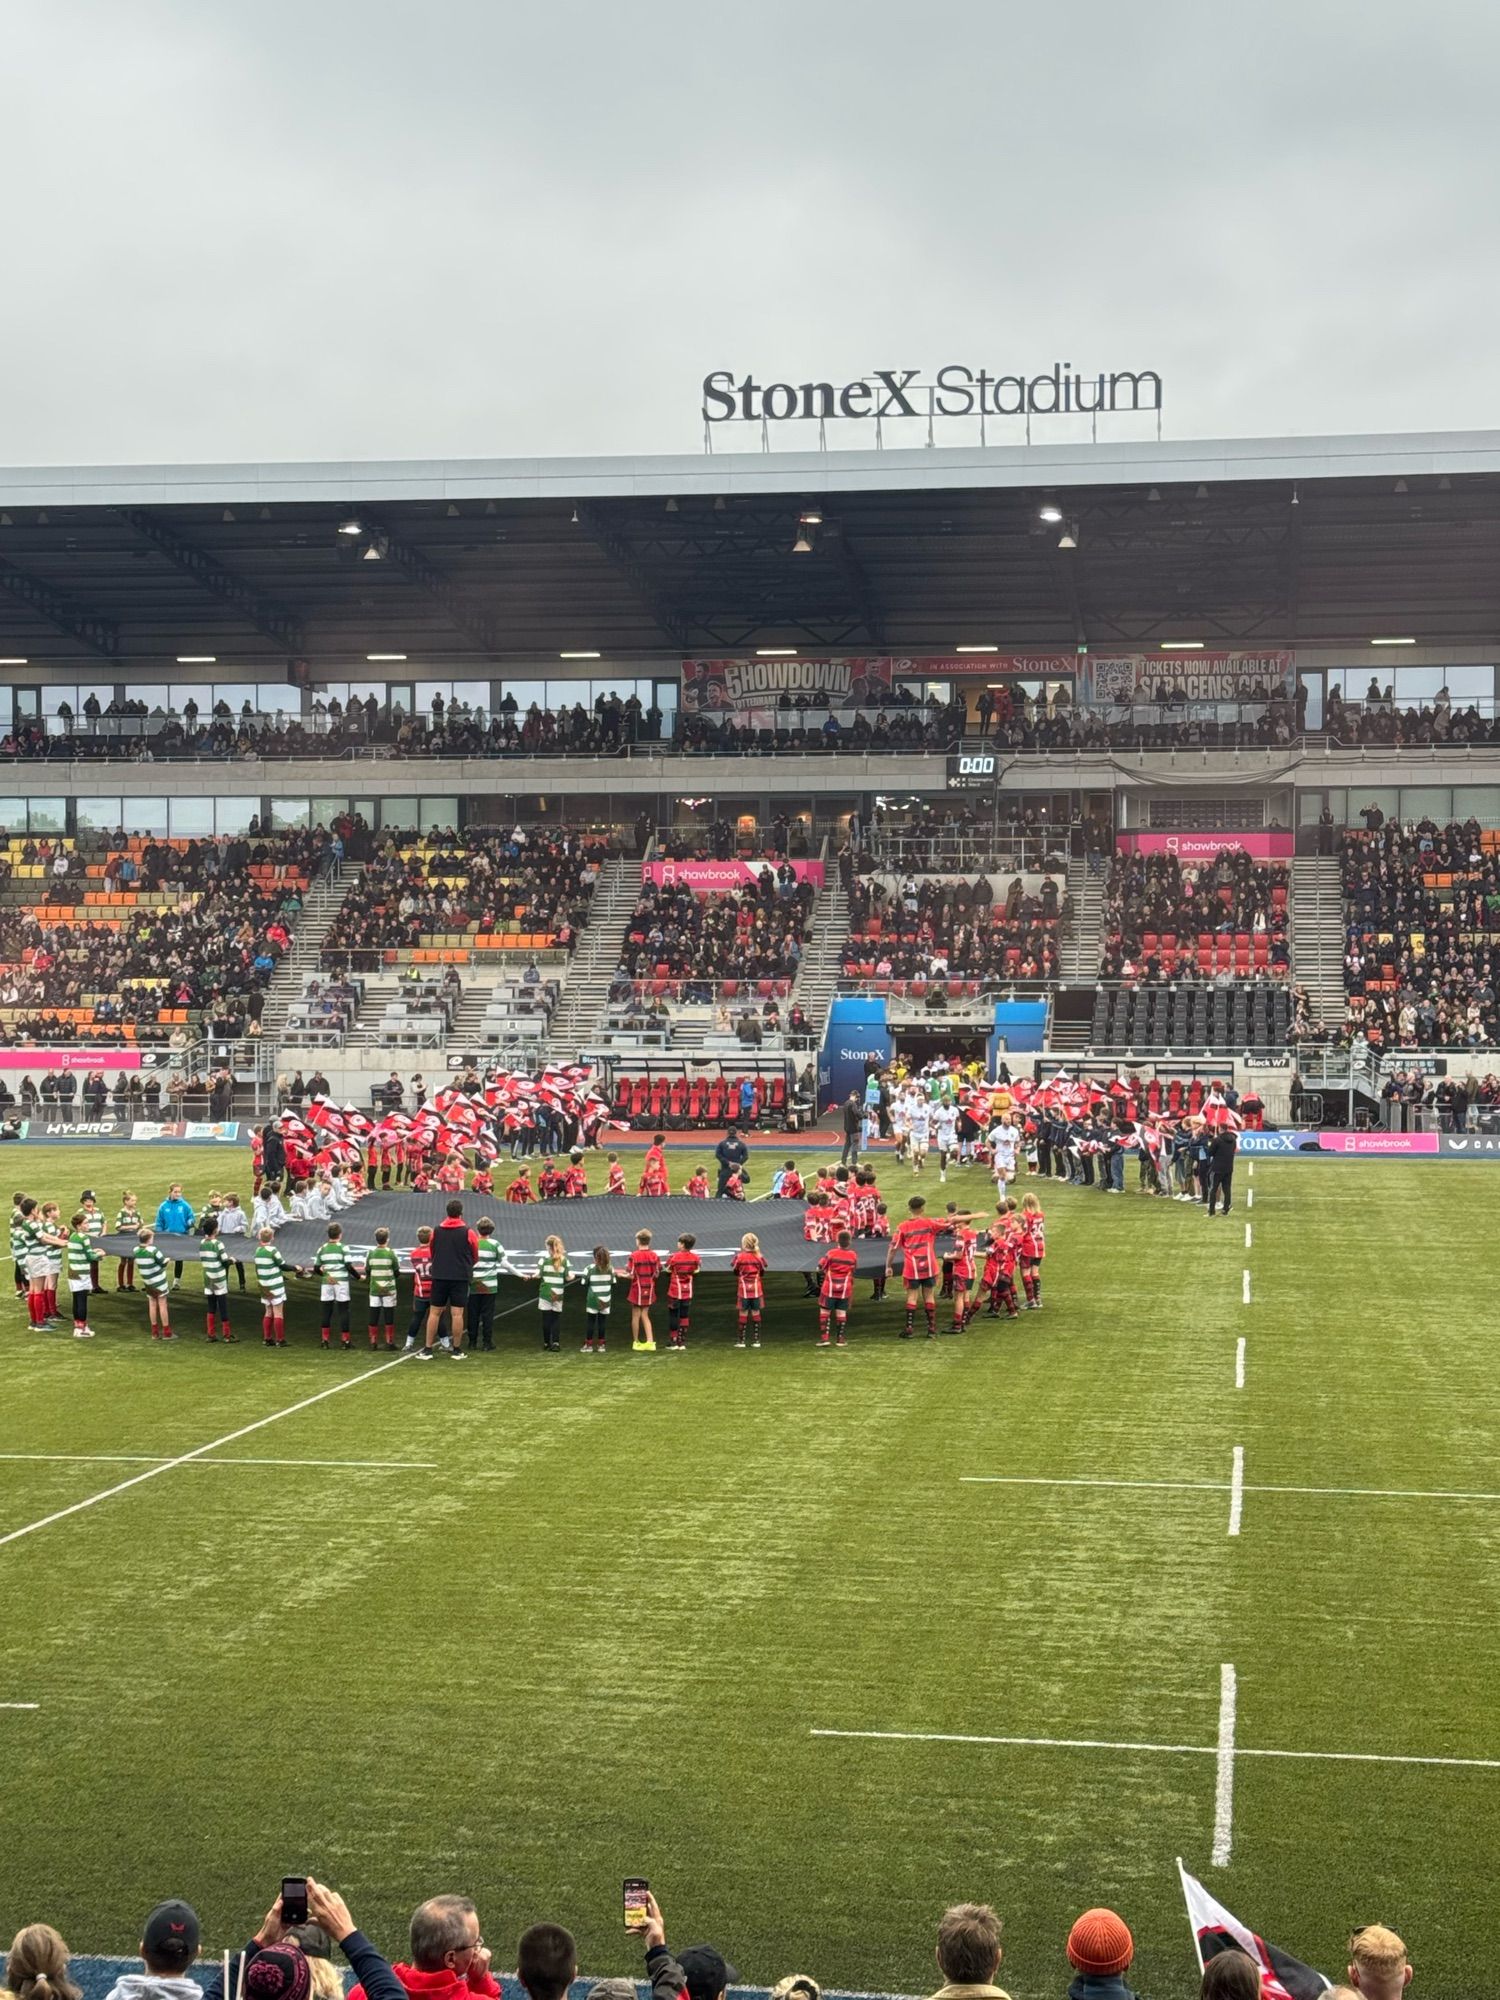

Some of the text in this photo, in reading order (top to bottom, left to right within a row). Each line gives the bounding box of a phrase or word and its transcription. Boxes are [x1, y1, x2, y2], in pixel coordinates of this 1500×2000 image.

[702, 362, 1162, 421] StoneX Stadium
[1012, 656, 1074, 672] StoneX
[1140, 659, 1282, 675] TICKETS NOW AVAILABLE AT
[959, 757, 994, 773] 0:00
[678, 868, 741, 880] shawbrook
[840, 1048, 884, 1060] StonX
[1247, 1059, 1270, 1067] Block
[46, 1122, 115, 1134] HY-PRO
[1236, 1135, 1295, 1151] toneX
[1358, 1139, 1412, 1148] shawbrook
